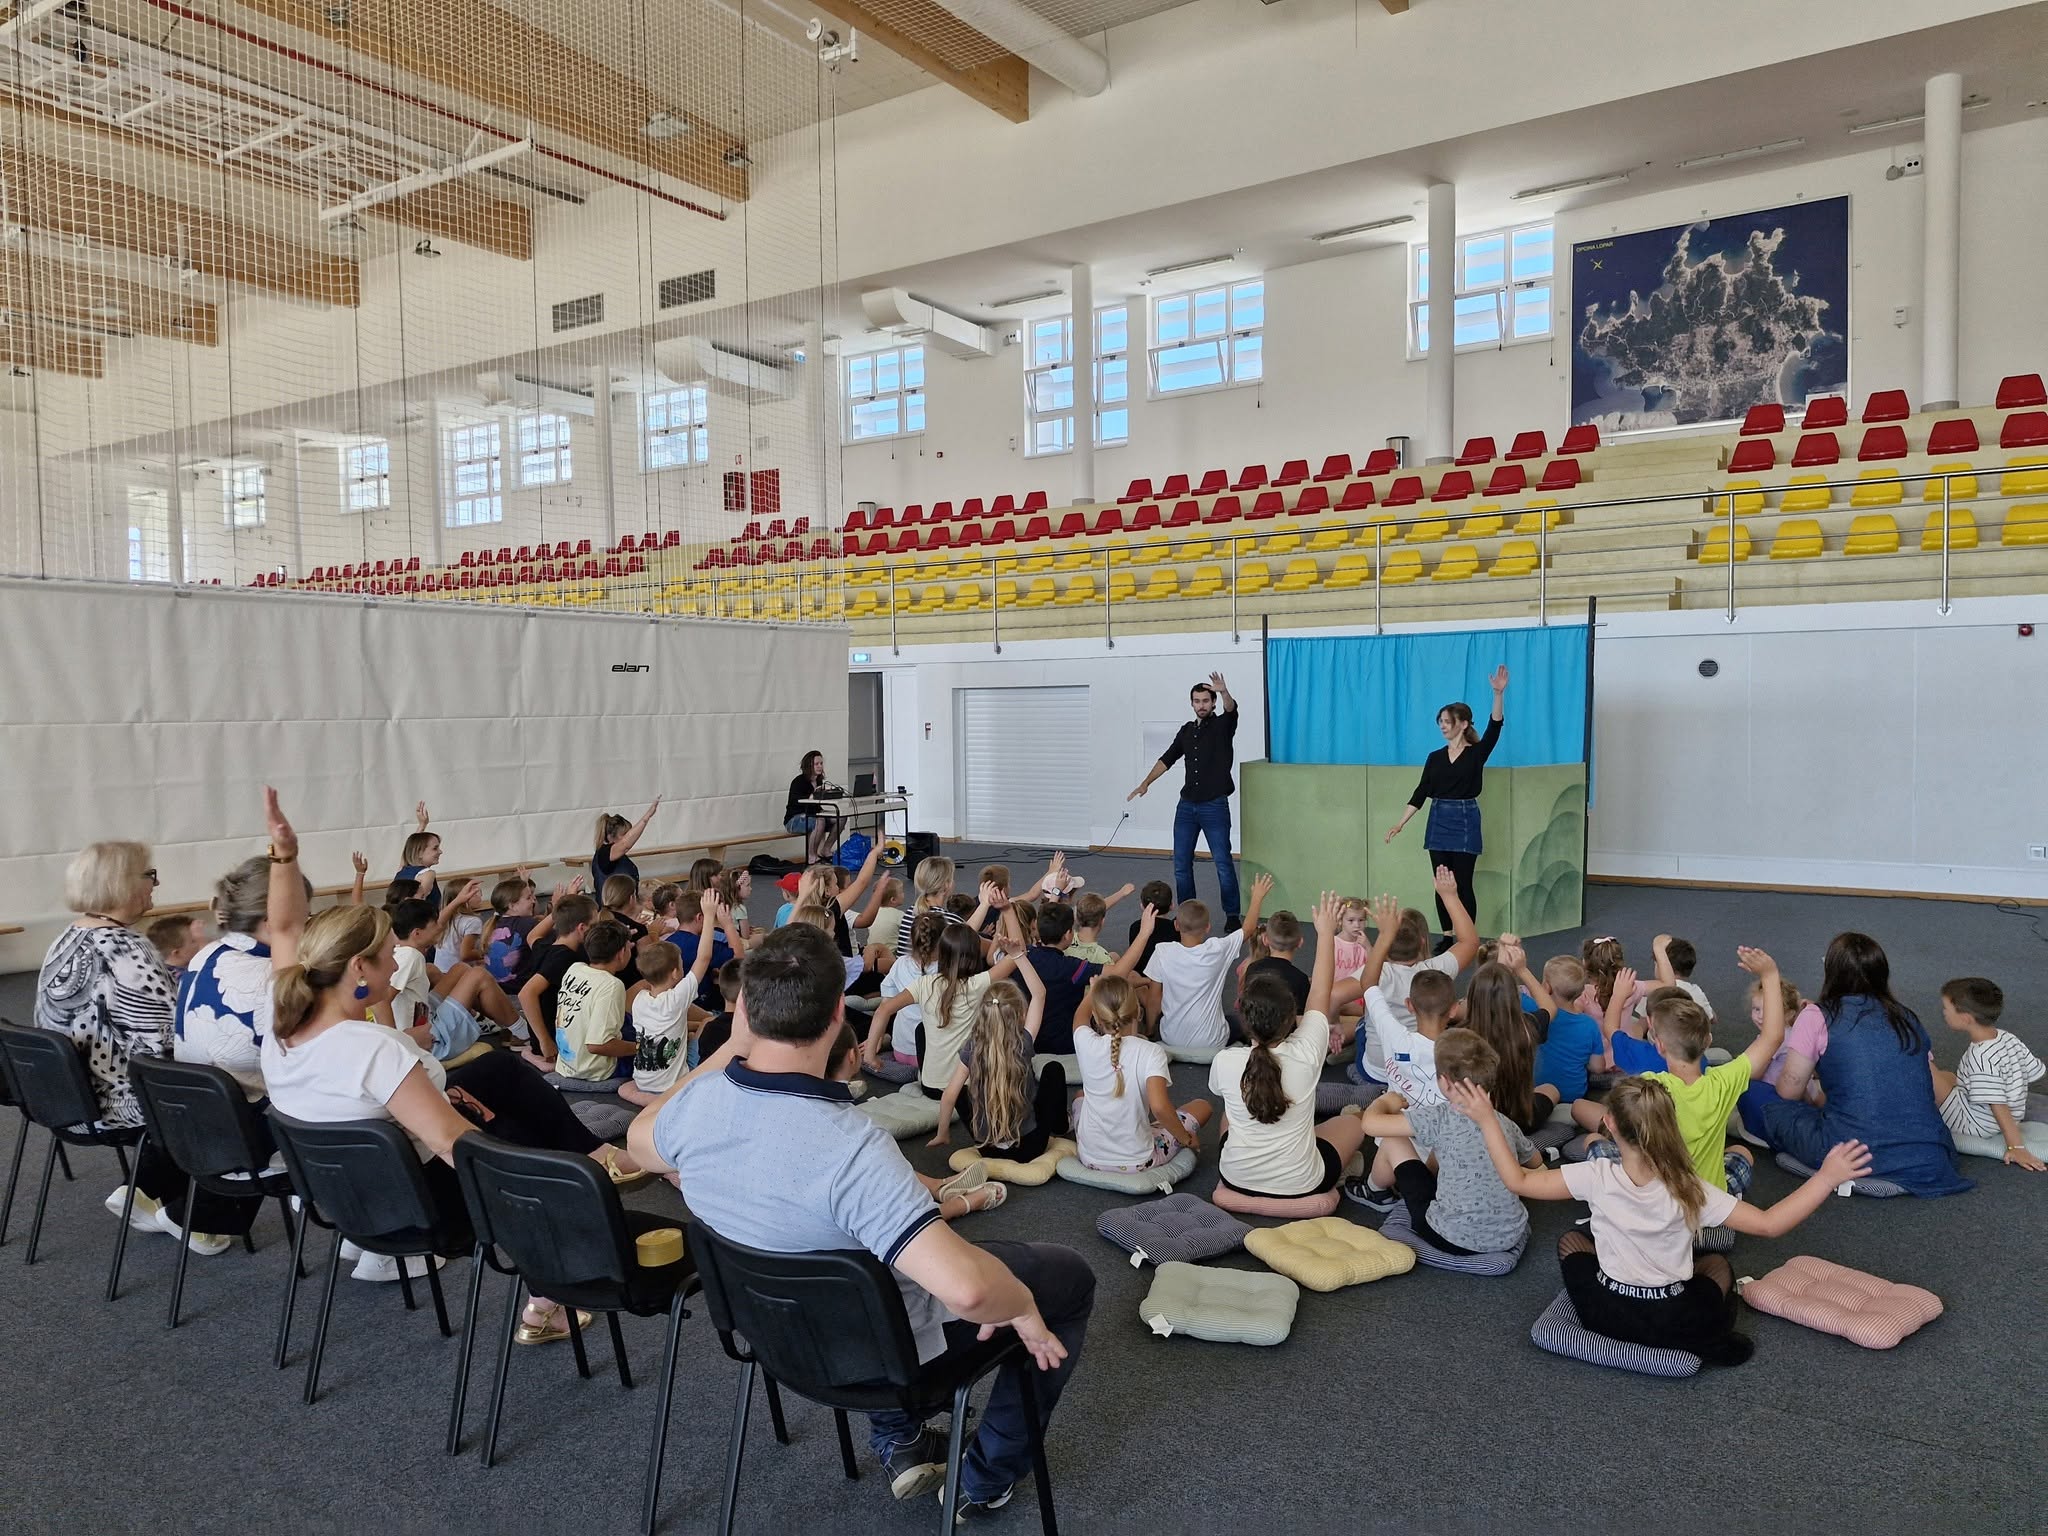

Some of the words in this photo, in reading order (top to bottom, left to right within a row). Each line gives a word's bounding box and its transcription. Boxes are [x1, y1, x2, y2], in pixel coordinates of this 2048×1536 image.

[611, 662, 650, 672] elan
[557, 990, 582, 1012] Days
[1608, 1280, 1669, 1300] #GIRLTALK
